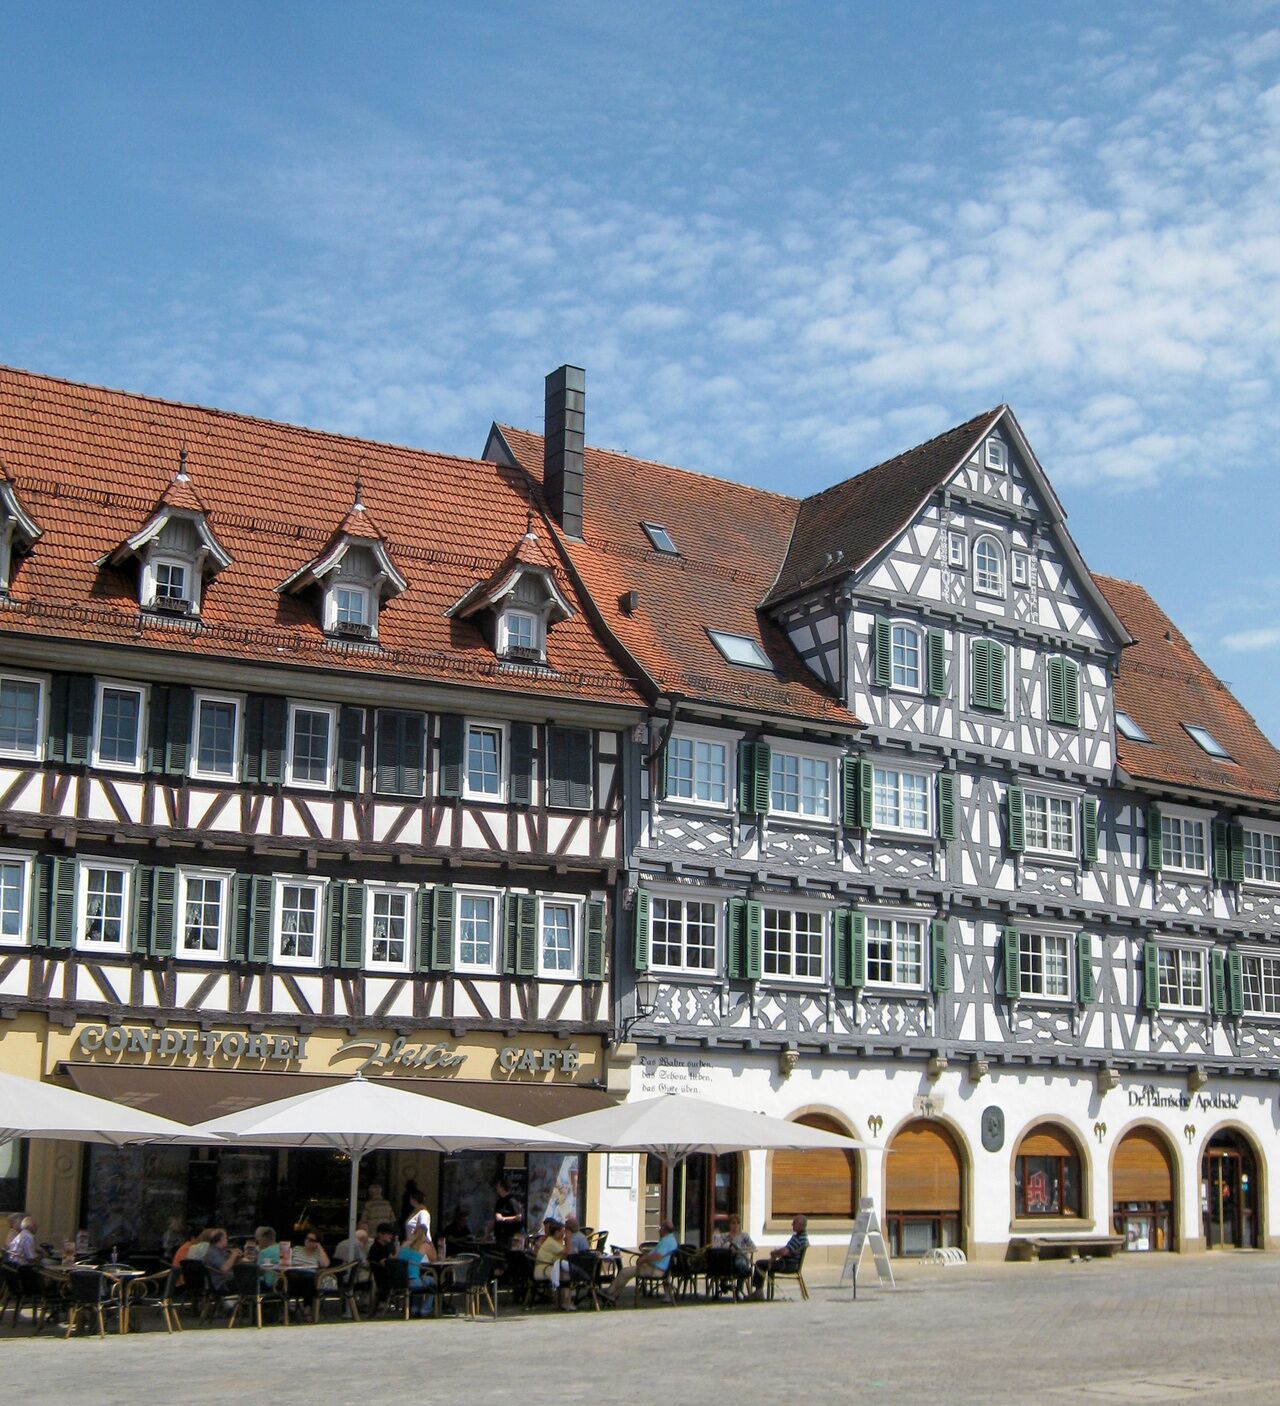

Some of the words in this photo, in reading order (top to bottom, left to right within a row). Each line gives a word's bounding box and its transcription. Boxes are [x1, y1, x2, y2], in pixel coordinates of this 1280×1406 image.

[79, 1026, 309, 1060] CONDITOREI
[499, 1043, 581, 1072] CAFÉ
[1196, 1092, 1239, 1113] Apotheke
